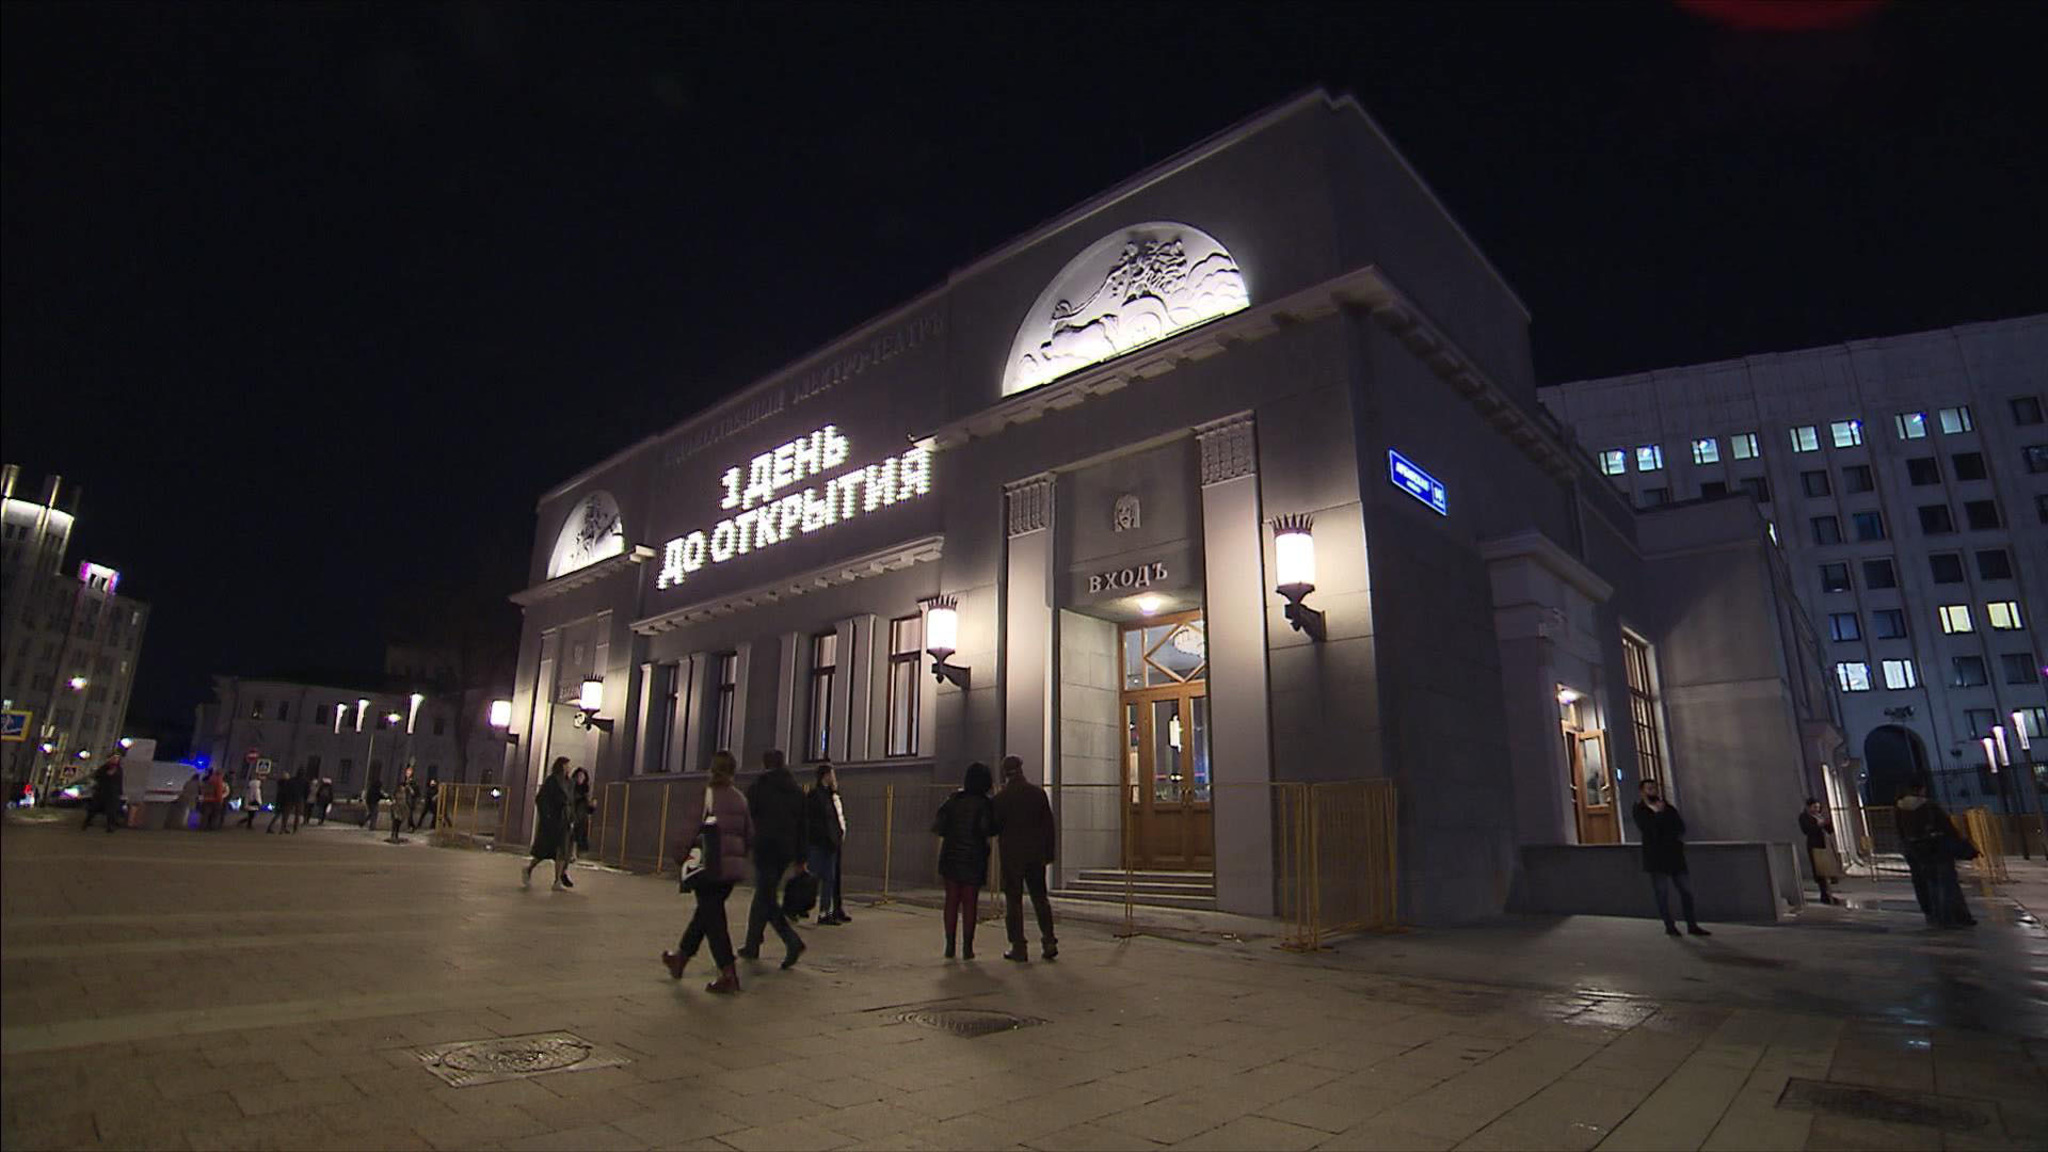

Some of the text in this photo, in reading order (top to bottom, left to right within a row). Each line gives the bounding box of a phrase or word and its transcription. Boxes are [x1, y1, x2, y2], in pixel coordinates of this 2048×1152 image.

[721, 466, 742, 510] 1
[743, 424, 849, 511] ДЕНЬ
[656, 448, 932, 590] ДО ОТКРЫТИЯ
[1088, 562, 1168, 594] ВХОДЪ
